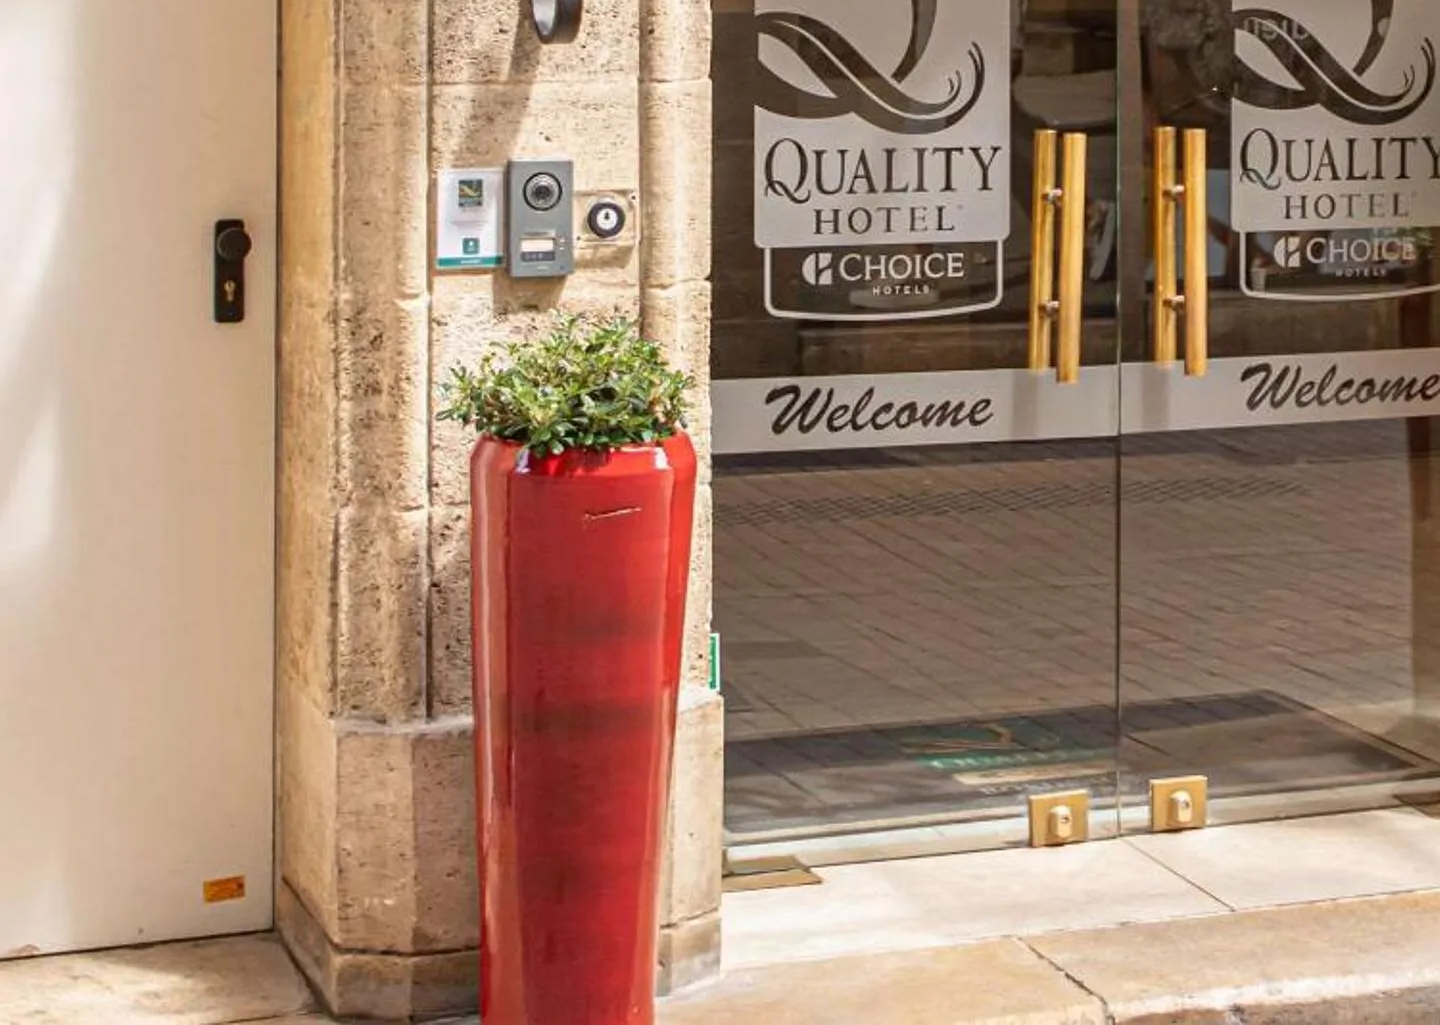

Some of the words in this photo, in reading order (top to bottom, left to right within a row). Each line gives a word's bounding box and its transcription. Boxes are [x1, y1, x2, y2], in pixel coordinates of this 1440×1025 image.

[764, 137, 1003, 204] QUALITY
[1284, 192, 1411, 220] HOTEL
[814, 206, 956, 235] HOTEL
[1306, 237, 1418, 264] CHOICE
[839, 253, 966, 281] CHOICE
[872, 285, 931, 296] HOTELS
[764, 384, 994, 435] Welcome
